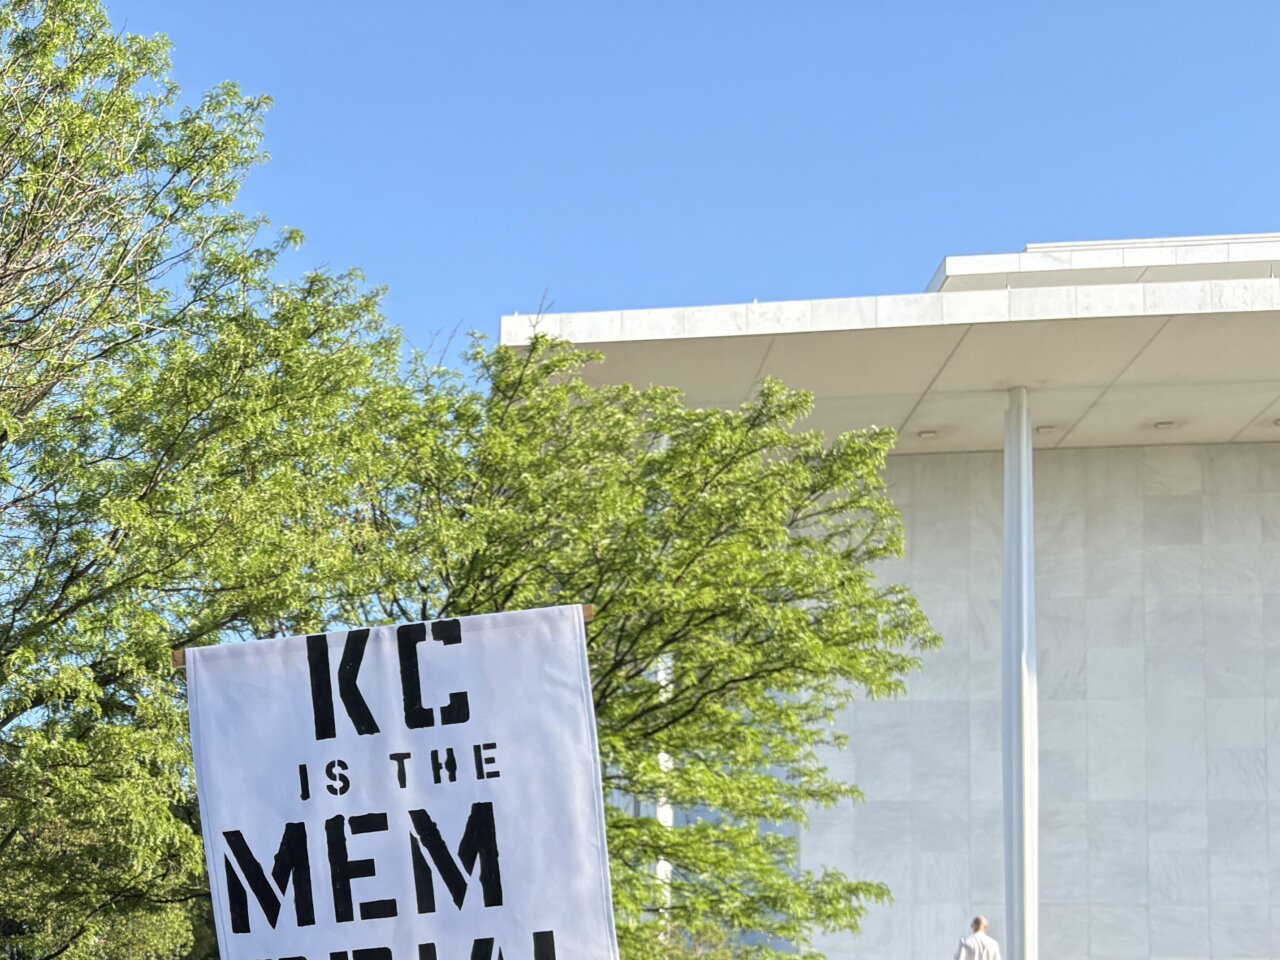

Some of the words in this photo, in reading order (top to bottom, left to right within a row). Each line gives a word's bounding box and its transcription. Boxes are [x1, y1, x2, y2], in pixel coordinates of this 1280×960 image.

[307, 618, 470, 740] KC
[299, 759, 350, 800] IS
[389, 742, 501, 789] THE
[222, 802, 504, 934] MEM
